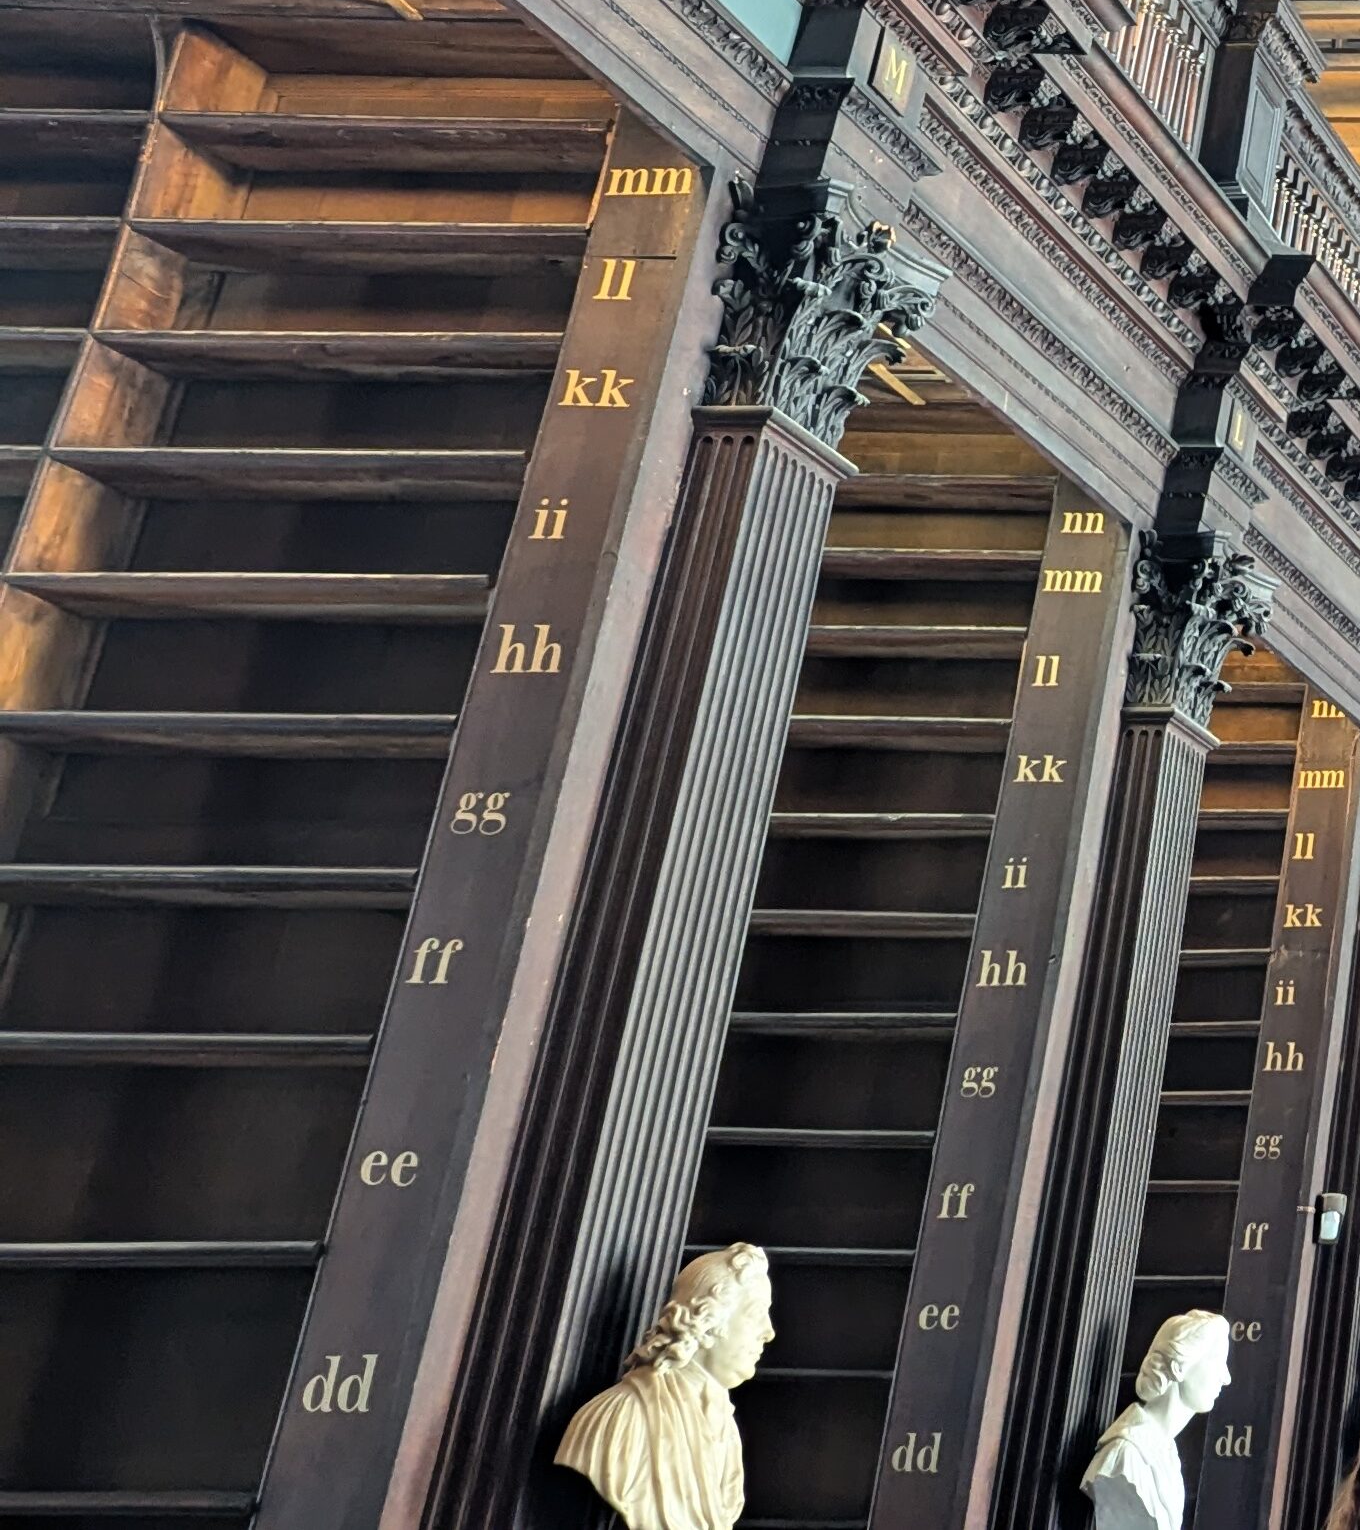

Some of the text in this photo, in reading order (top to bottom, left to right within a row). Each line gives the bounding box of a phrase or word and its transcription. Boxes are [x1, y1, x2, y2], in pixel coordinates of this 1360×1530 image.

[885, 46, 909, 95] M
[604, 165, 692, 196] mm
[591, 258, 636, 301] ll
[557, 369, 635, 408] kk
[1233, 412, 1245, 447] L
[528, 498, 570, 540] ii
[1060, 511, 1105, 534] nn
[1041, 569, 1103, 593] mm
[490, 624, 562, 673] hh
[1032, 655, 1061, 687] ll
[1013, 755, 1068, 783] kk
[1298, 769, 1345, 789] mm
[449, 791, 510, 835] gg
[1292, 833, 1315, 860] ll
[1002, 857, 1028, 889] ii
[1283, 904, 1323, 928] kk
[404, 937, 465, 985] ff
[976, 950, 1028, 988] hh
[1274, 980, 1295, 1006] ii
[1262, 1041, 1304, 1071] hh
[960, 1065, 999, 1098] gg
[1253, 1133, 1284, 1160] gg
[359, 1149, 420, 1187] ee
[937, 1183, 976, 1219] ff
[1240, 1222, 1269, 1251] ff
[918, 1302, 961, 1331] ee
[1230, 1319, 1262, 1342] ee
[302, 1354, 379, 1413] dd
[891, 1432, 942, 1474] dd
[1215, 1425, 1253, 1458] dd
